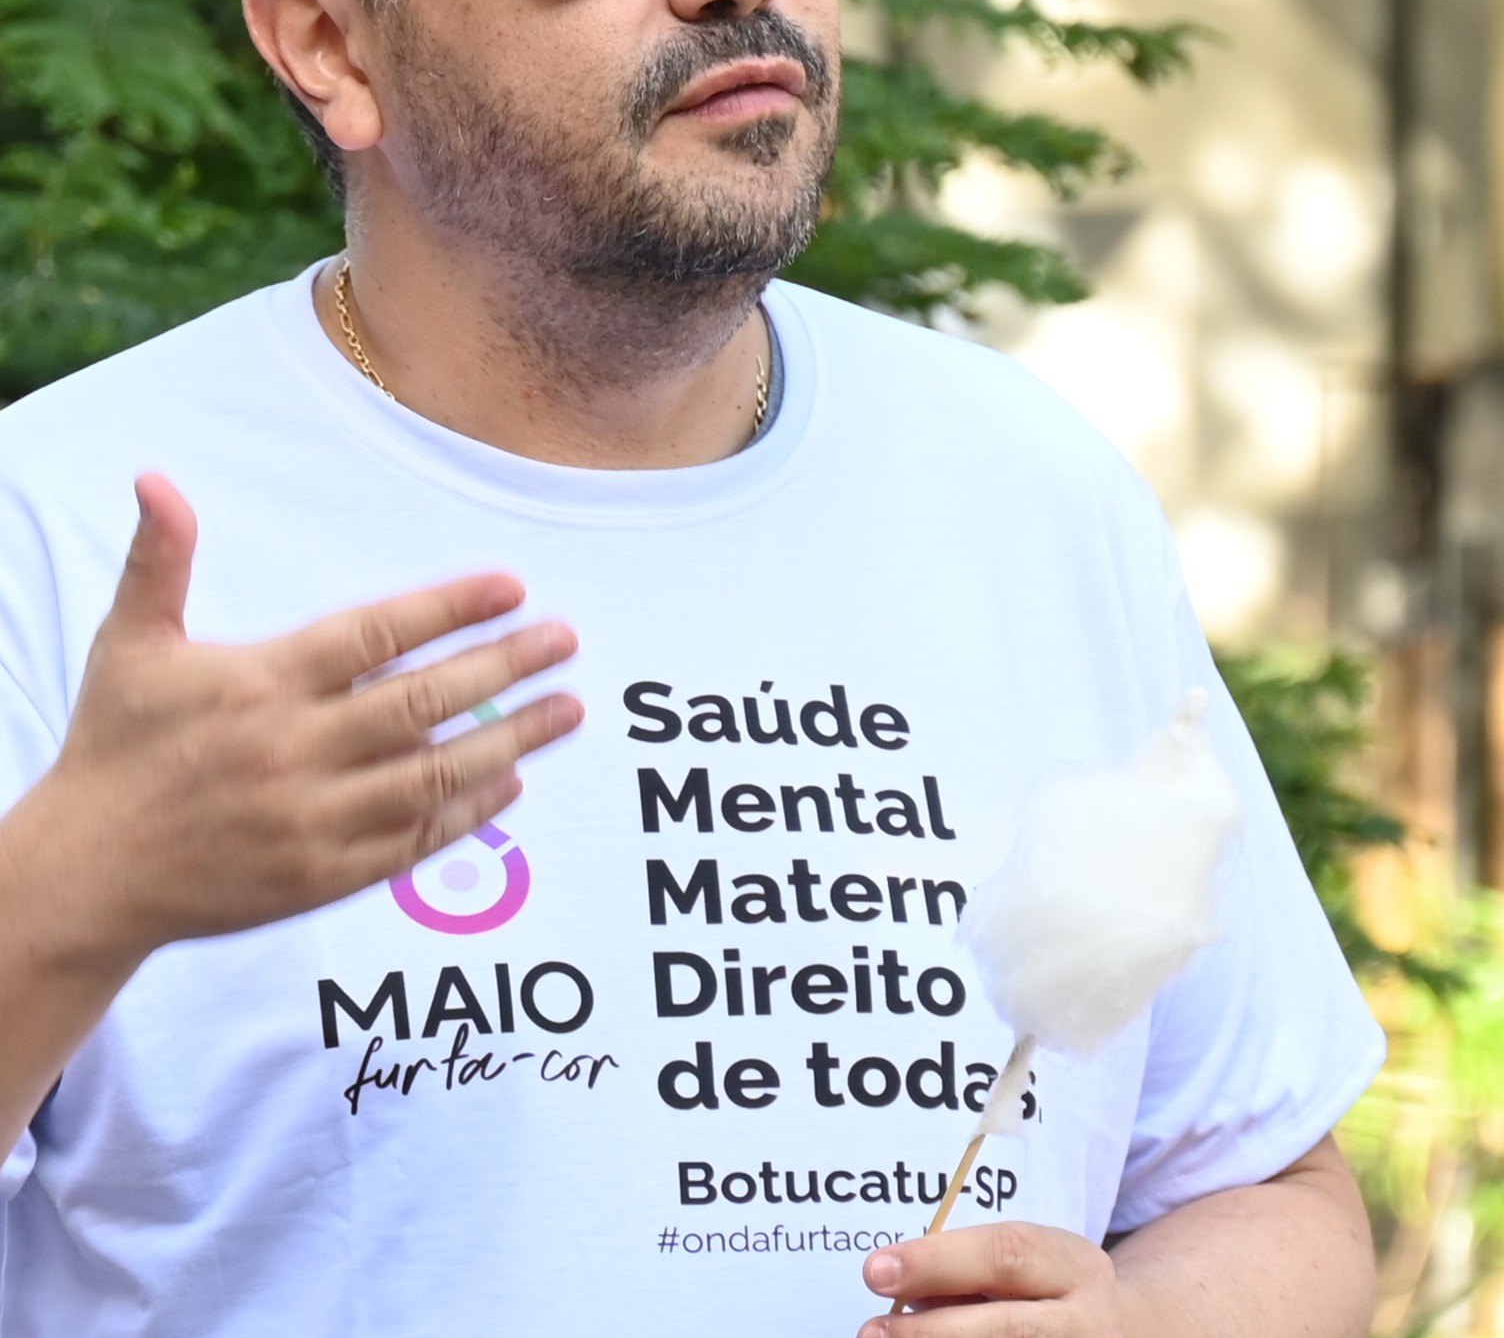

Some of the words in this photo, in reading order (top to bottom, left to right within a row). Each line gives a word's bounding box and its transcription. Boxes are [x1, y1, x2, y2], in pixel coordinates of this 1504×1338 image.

[622, 679, 911, 752] Saúde
[636, 766, 957, 841] Mental
[645, 858, 968, 927] Matern
[316, 960, 595, 1050] MAIO
[652, 944, 967, 1019] Direito
[343, 1024, 620, 1117] furta-cor
[656, 1040, 781, 1111] de
[805, 1040, 1042, 1124] toda
[677, 1160, 1019, 1213] Botucatu-SP
[656, 1223, 930, 1256] #ondafurtacor
